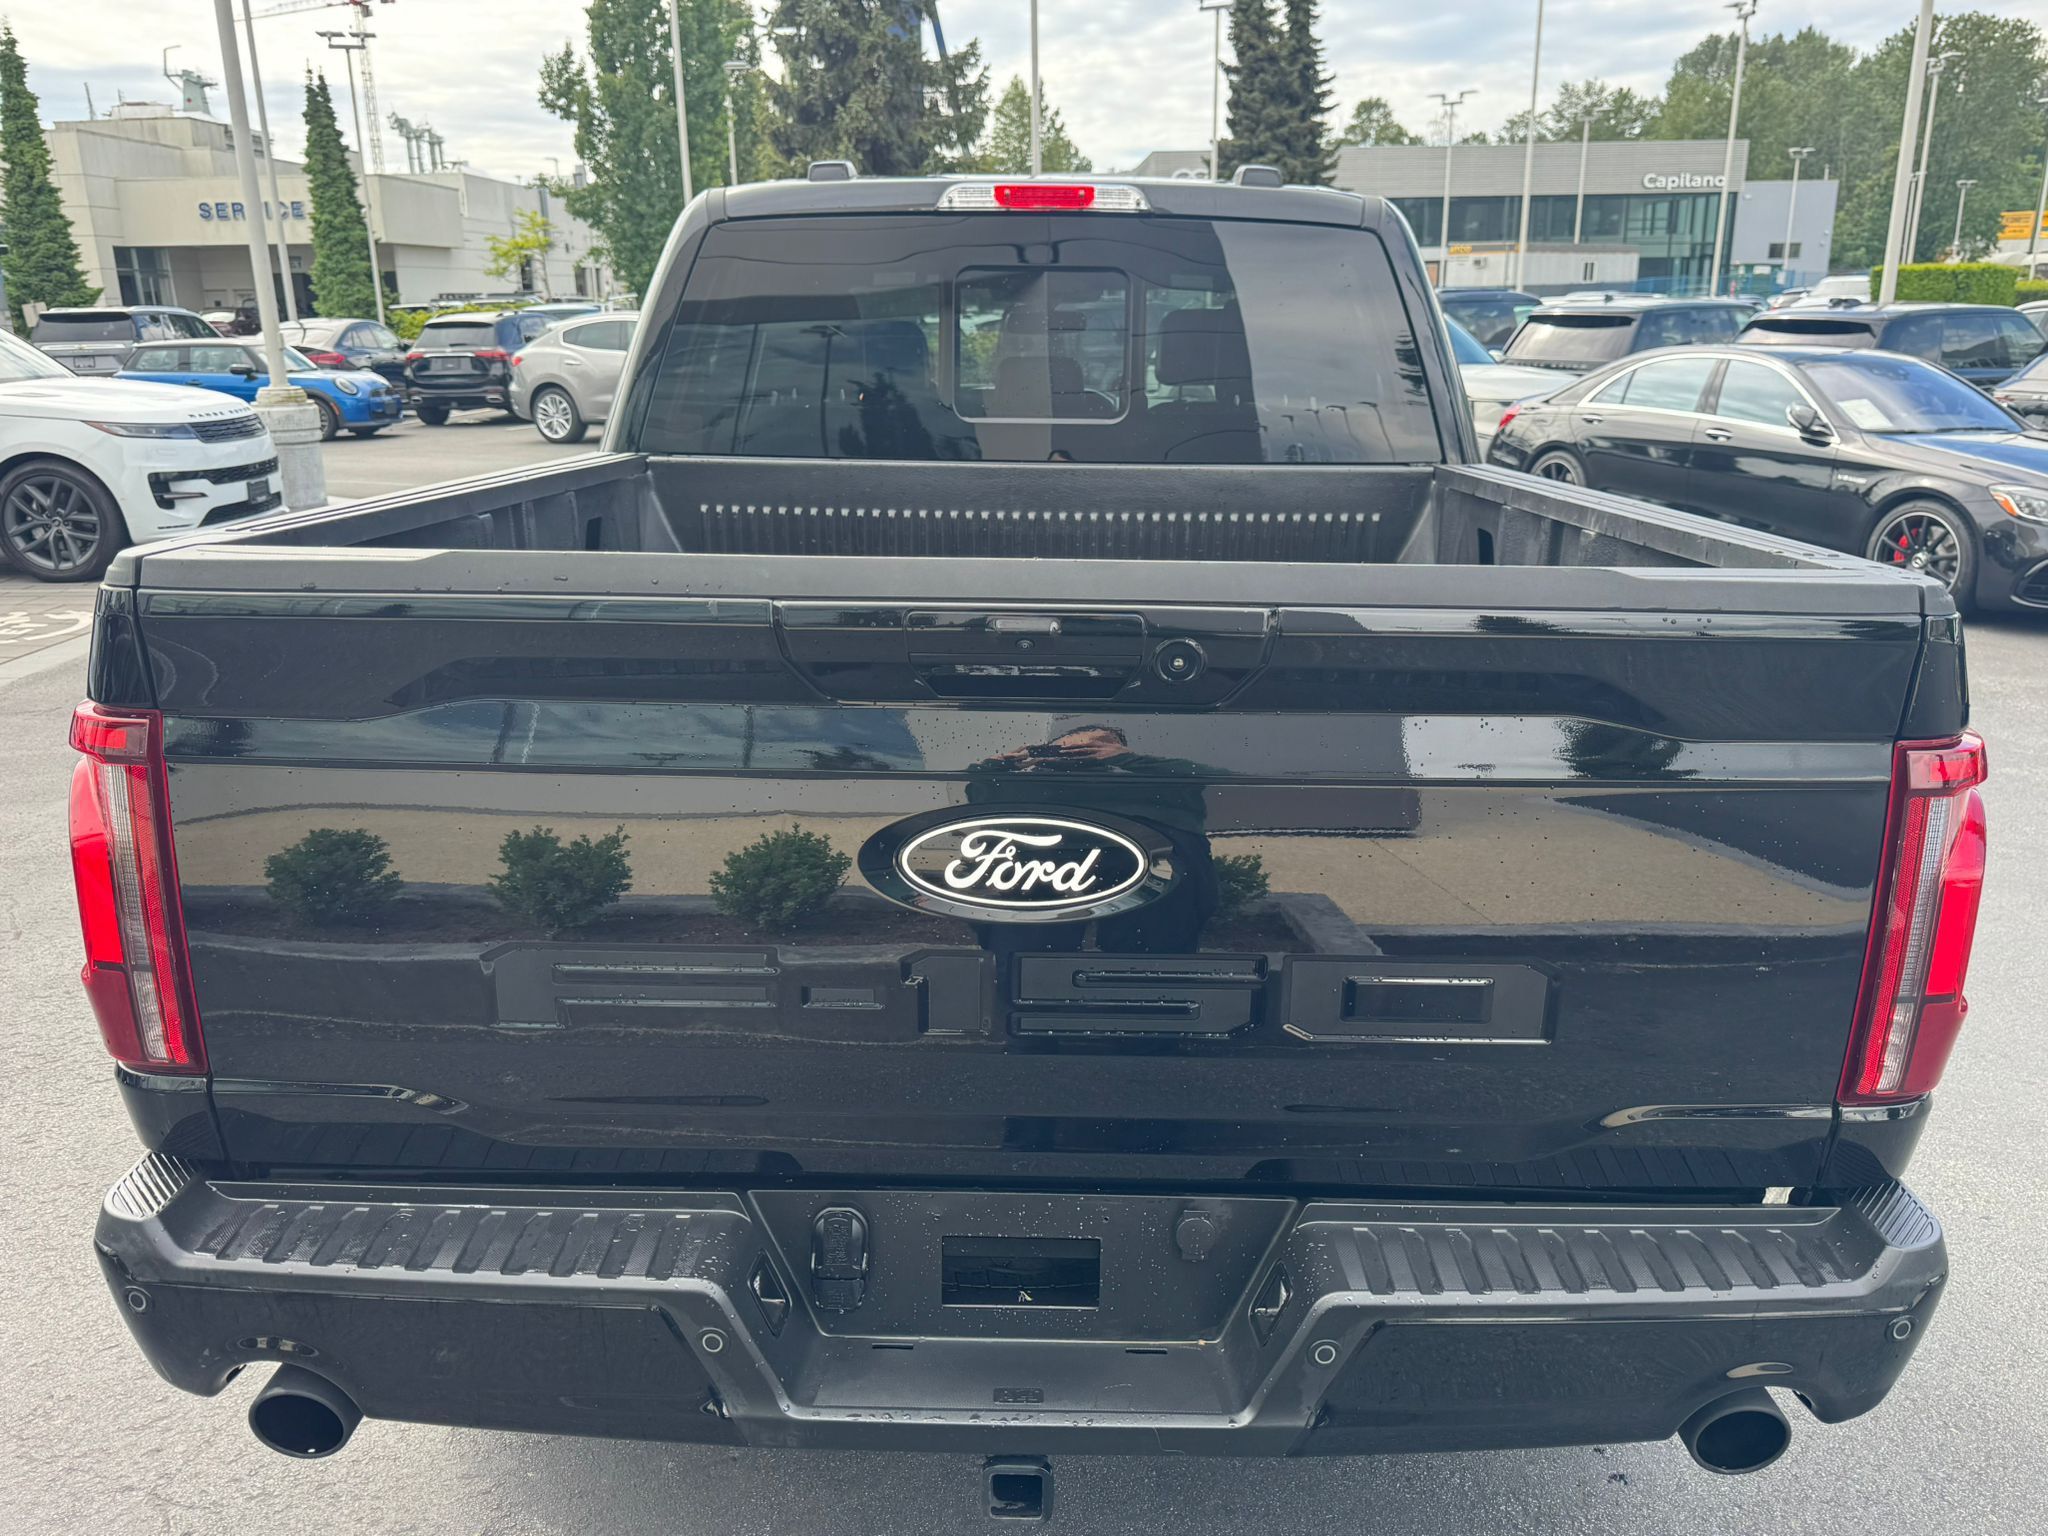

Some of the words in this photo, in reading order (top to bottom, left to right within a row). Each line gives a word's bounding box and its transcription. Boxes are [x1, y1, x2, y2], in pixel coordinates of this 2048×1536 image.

[1643, 172, 1727, 191] Capilano
[198, 201, 305, 221] SERICE
[944, 830, 1101, 892] Ford
[490, 944, 1551, 1045] F-150
